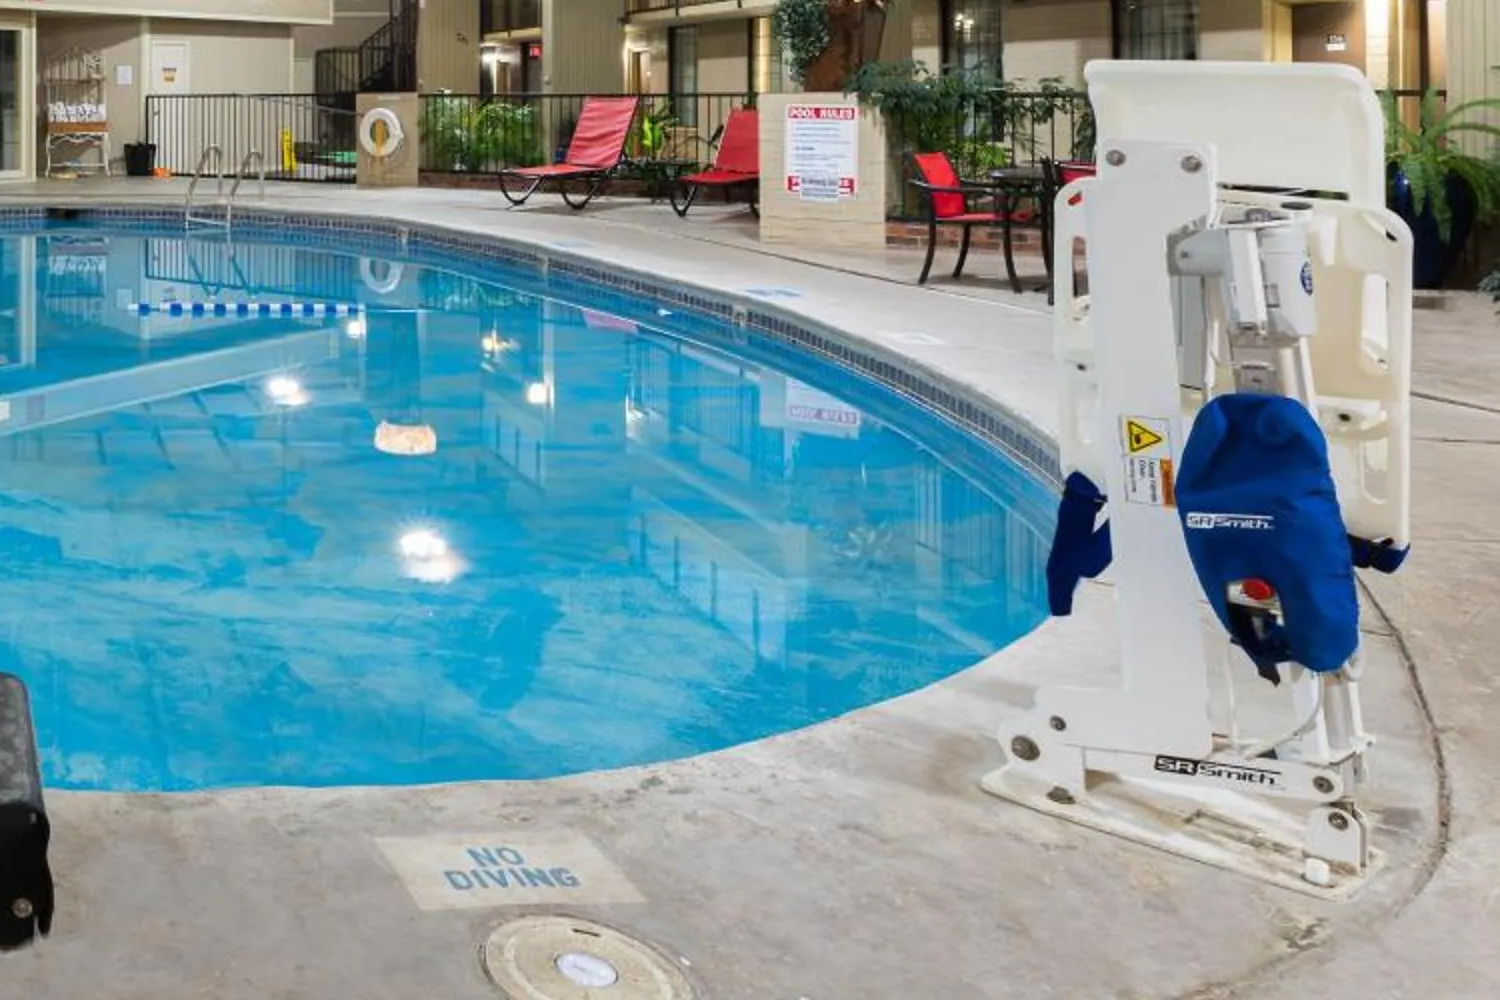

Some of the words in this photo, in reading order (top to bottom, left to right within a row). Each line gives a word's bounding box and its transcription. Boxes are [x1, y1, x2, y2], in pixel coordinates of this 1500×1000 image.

[789, 108, 815, 118] POOL
[819, 108, 853, 119] RULES
[467, 846, 524, 867] NO
[444, 867, 580, 890] DIVING
